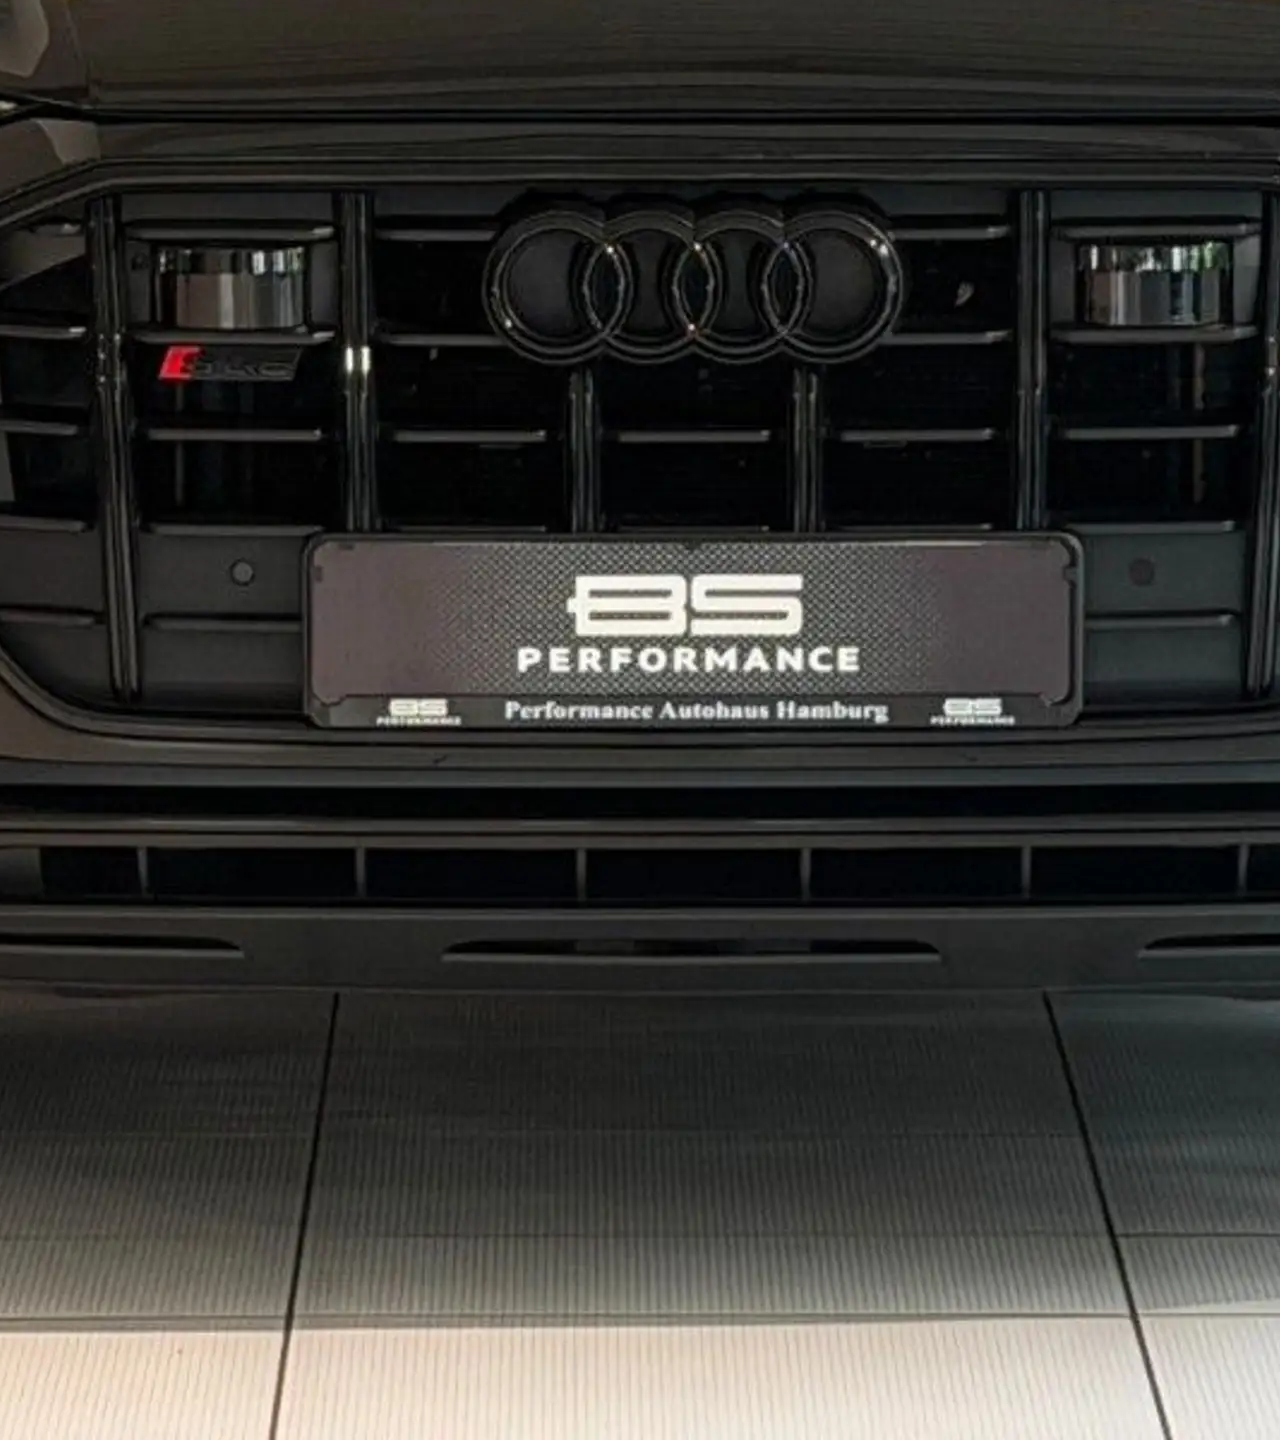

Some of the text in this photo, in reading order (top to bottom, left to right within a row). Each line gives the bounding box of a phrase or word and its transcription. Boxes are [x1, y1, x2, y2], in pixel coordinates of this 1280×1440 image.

[517, 646, 861, 674] PERFORMANCE
[504, 700, 890, 725] Performance Autohaus Hamburg
